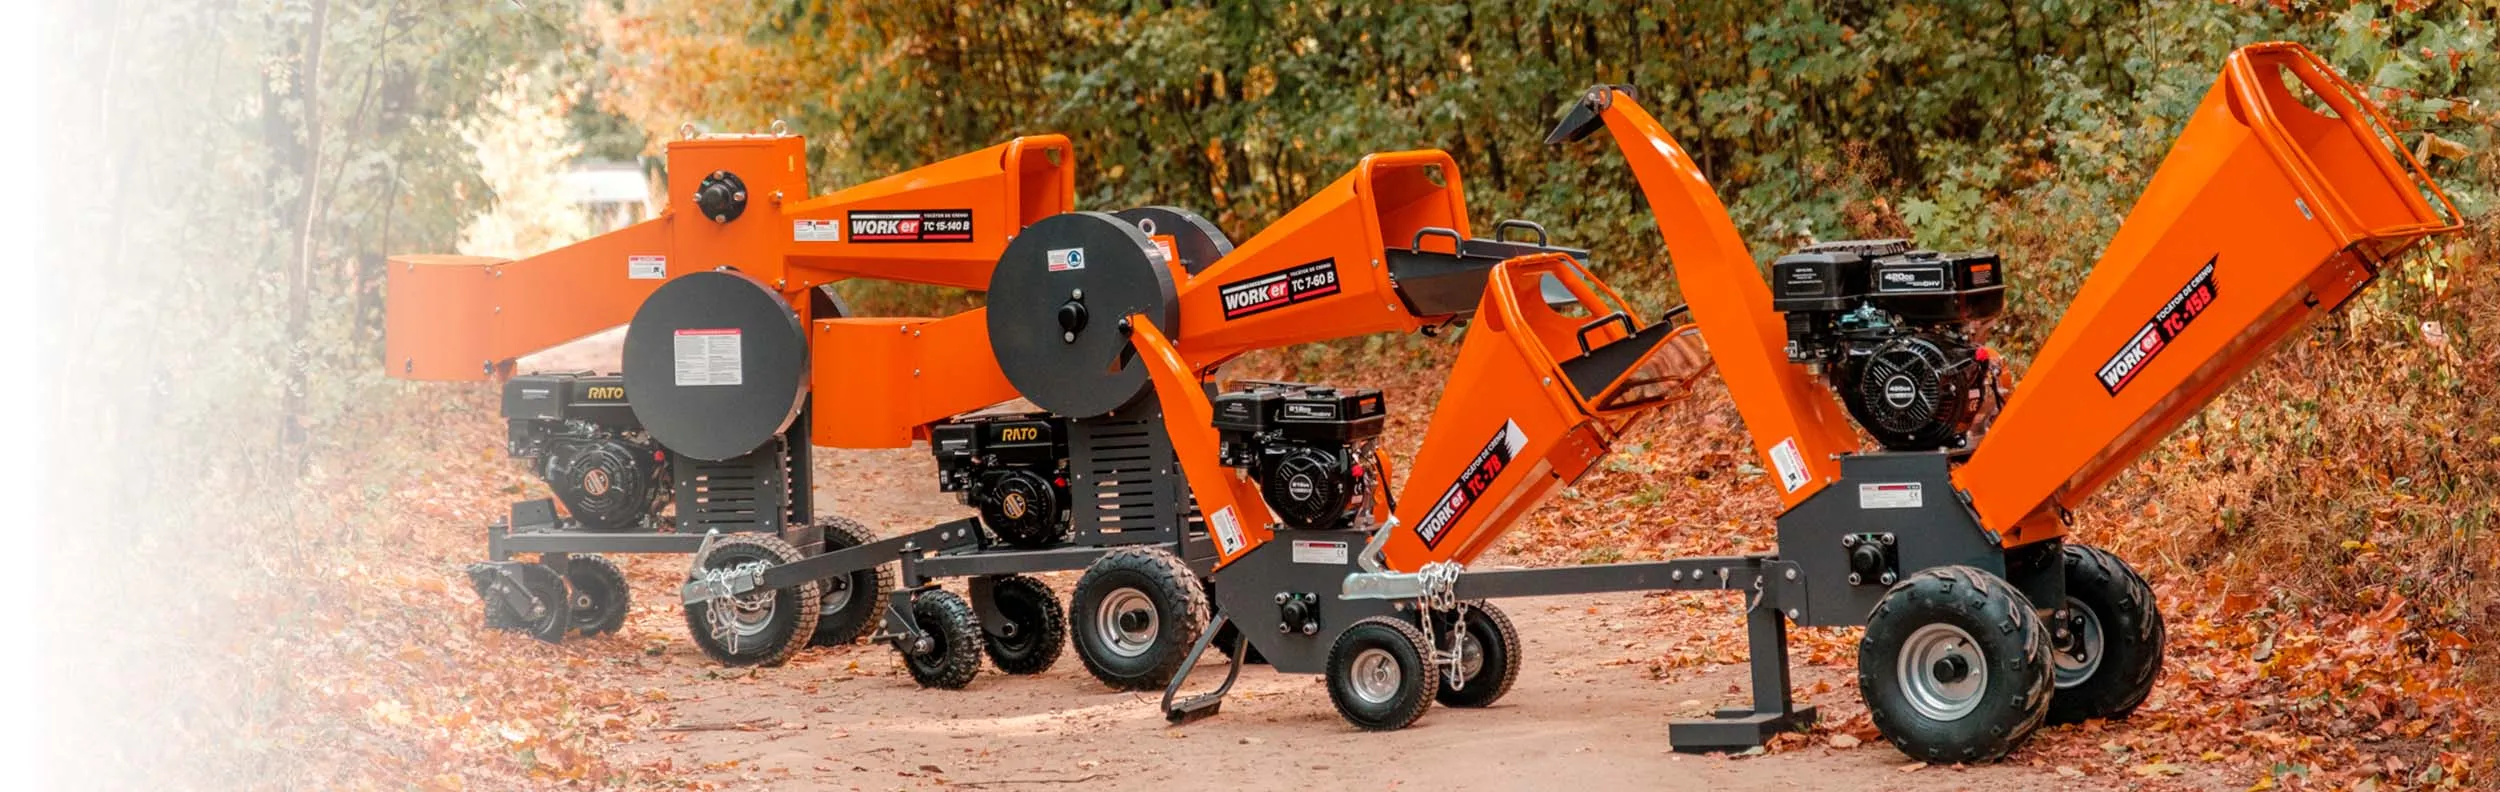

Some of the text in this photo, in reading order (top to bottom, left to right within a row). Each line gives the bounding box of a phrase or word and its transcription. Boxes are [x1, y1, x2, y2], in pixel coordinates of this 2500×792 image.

[852, 220, 917, 235] WORKer
[923, 220, 970, 231] TC 15-140 B
[1292, 271, 1335, 292] TC 7-60 B
[1225, 283, 1287, 310] WORKer
[2182, 285, 2192, 296] DE
[2103, 330, 2158, 386] WORKer
[588, 387, 624, 399] RATO
[1002, 427, 1037, 441] RATO
[1421, 488, 1465, 542] WORKer
